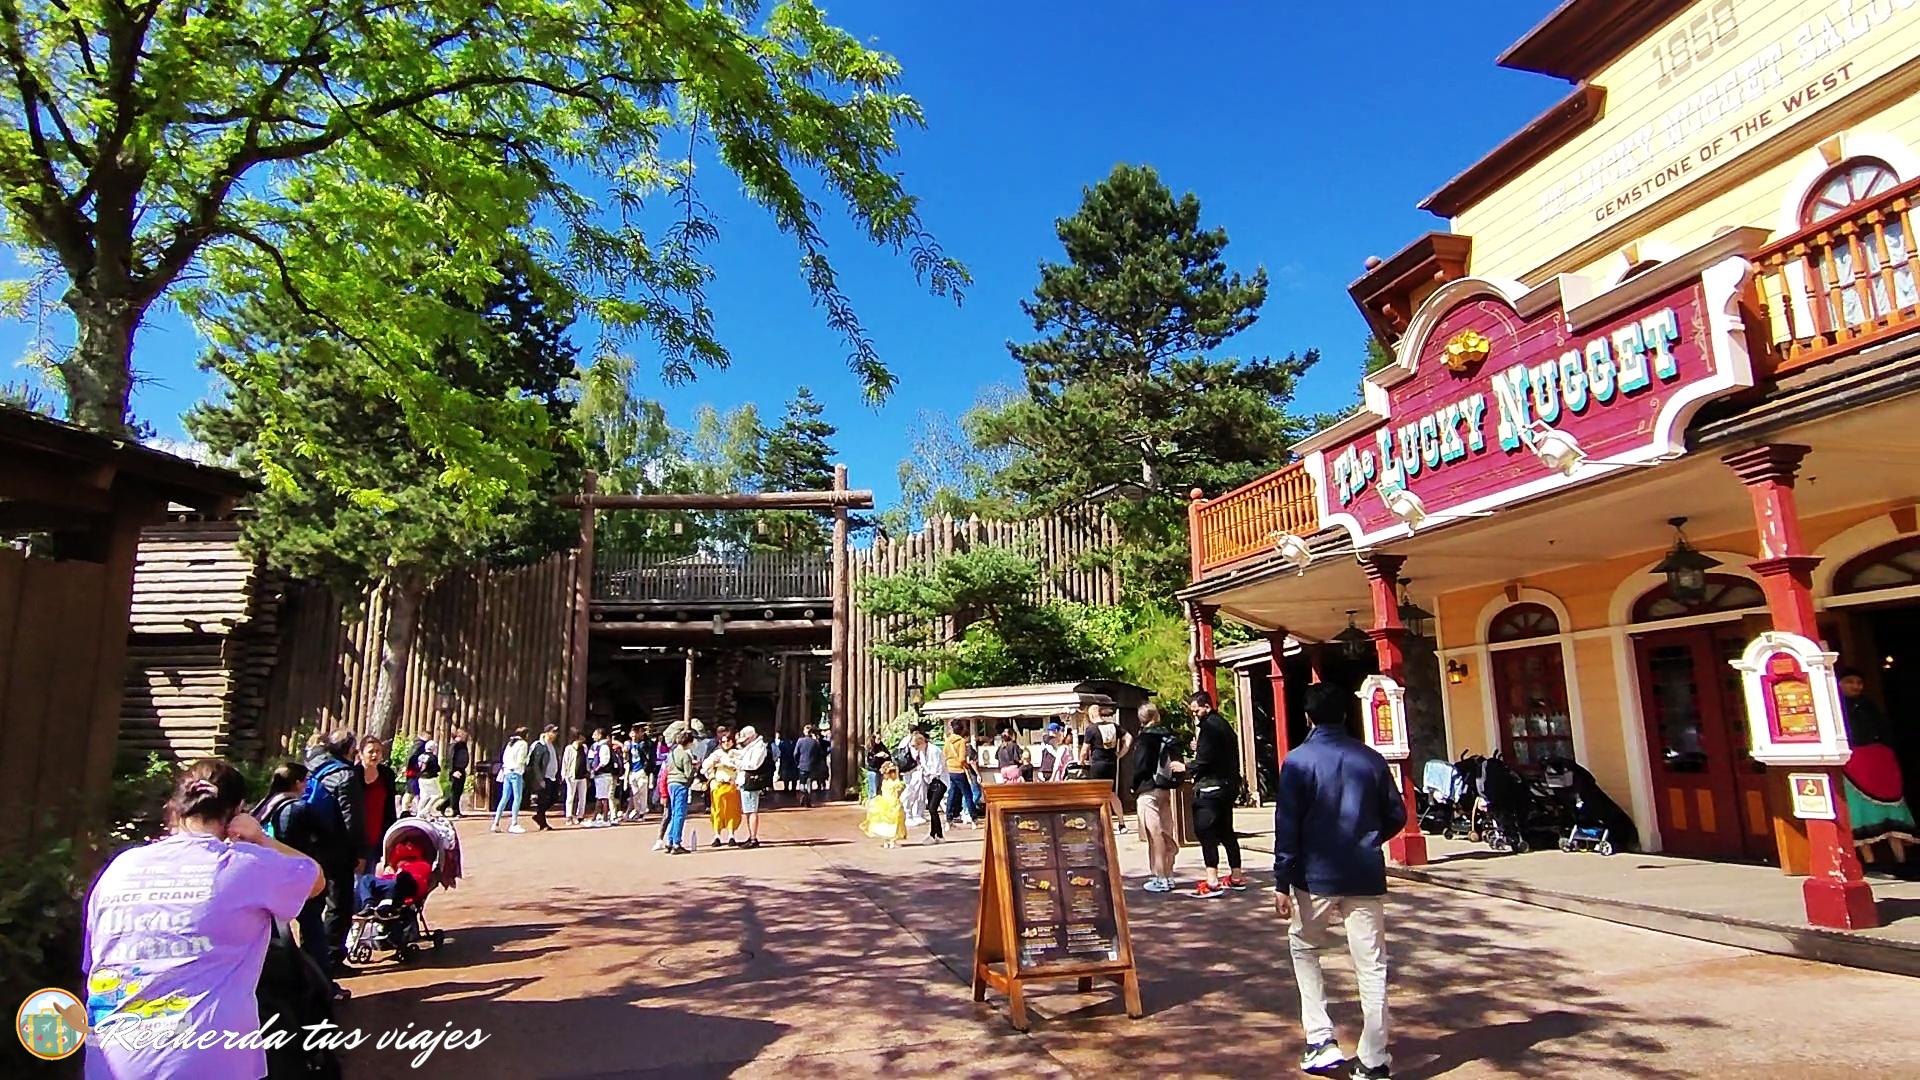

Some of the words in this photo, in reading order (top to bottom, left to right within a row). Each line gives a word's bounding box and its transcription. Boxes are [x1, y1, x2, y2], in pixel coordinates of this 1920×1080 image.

[1652, 0, 1739, 90] 1858
[1595, 156, 1692, 222] GEMSTONE
[1700, 137, 1723, 162] OF
[1730, 109, 1773, 142] THE
[1782, 62, 1854, 113] WEST
[1333, 443, 1376, 506] The
[1377, 393, 1485, 496] LUCKY
[1491, 307, 1679, 452] NUGGET
[148, 890, 207, 901] CRANE
